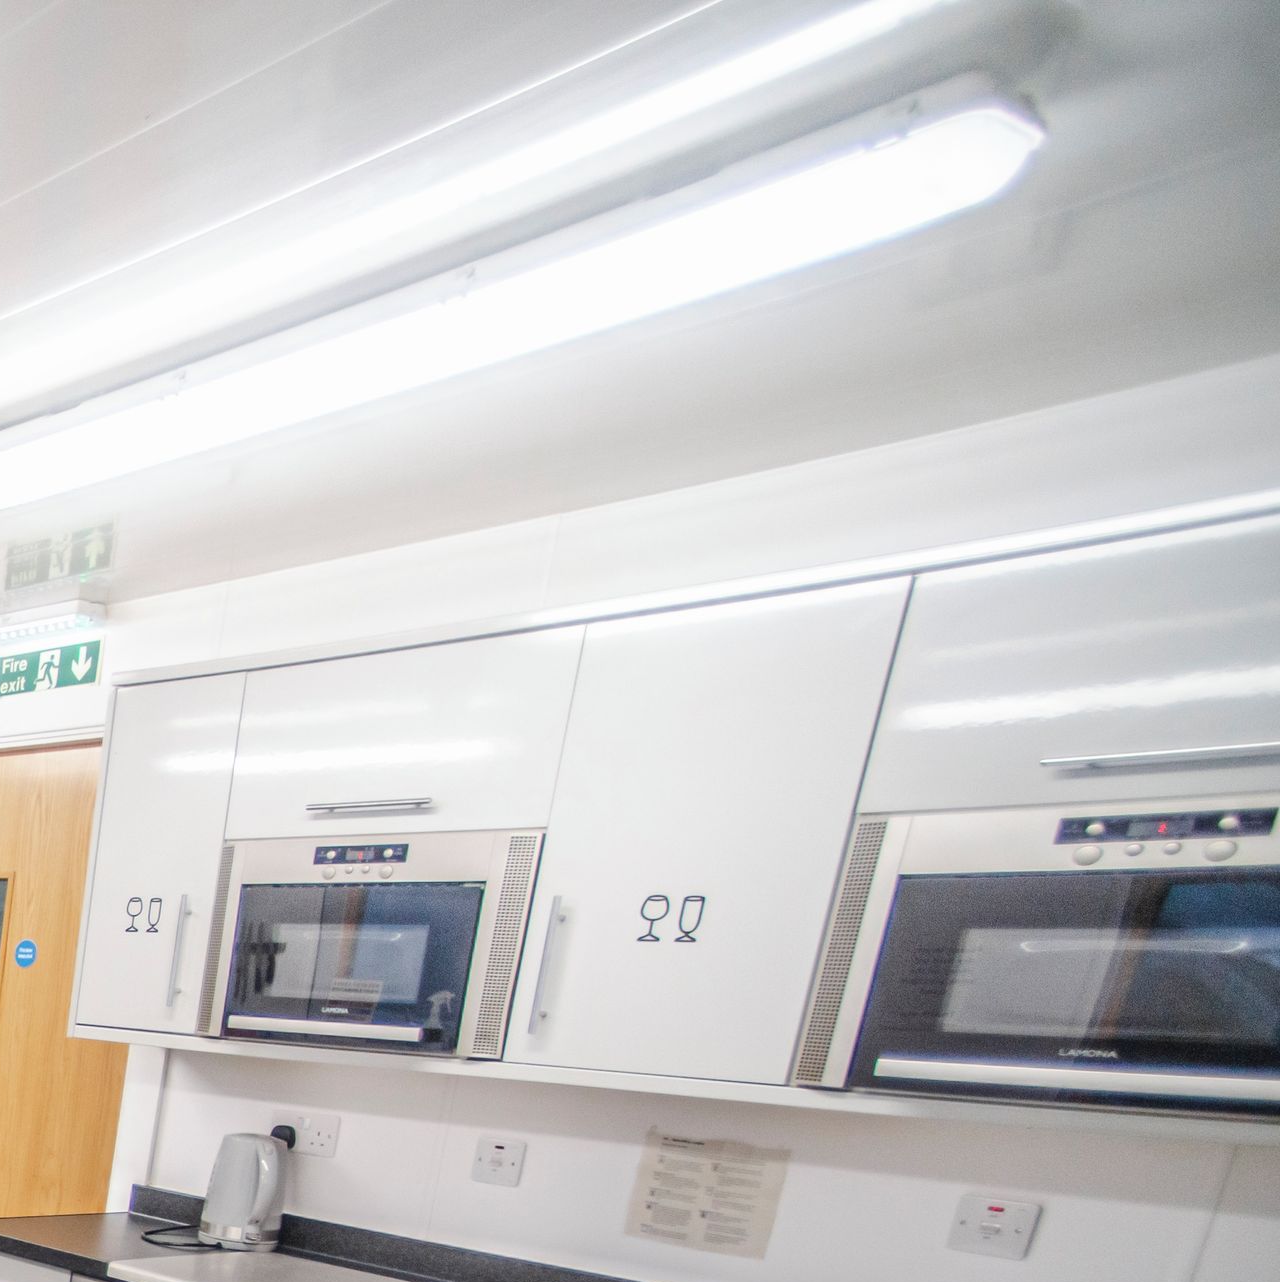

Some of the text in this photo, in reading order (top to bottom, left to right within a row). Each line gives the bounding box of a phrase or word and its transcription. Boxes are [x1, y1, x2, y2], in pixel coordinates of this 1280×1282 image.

[2, 658, 28, 674] Fire
[0, 676, 26, 694] exit
[321, 1006, 349, 1014] LAMONA
[1056, 1048, 1118, 1058] LAMONA
